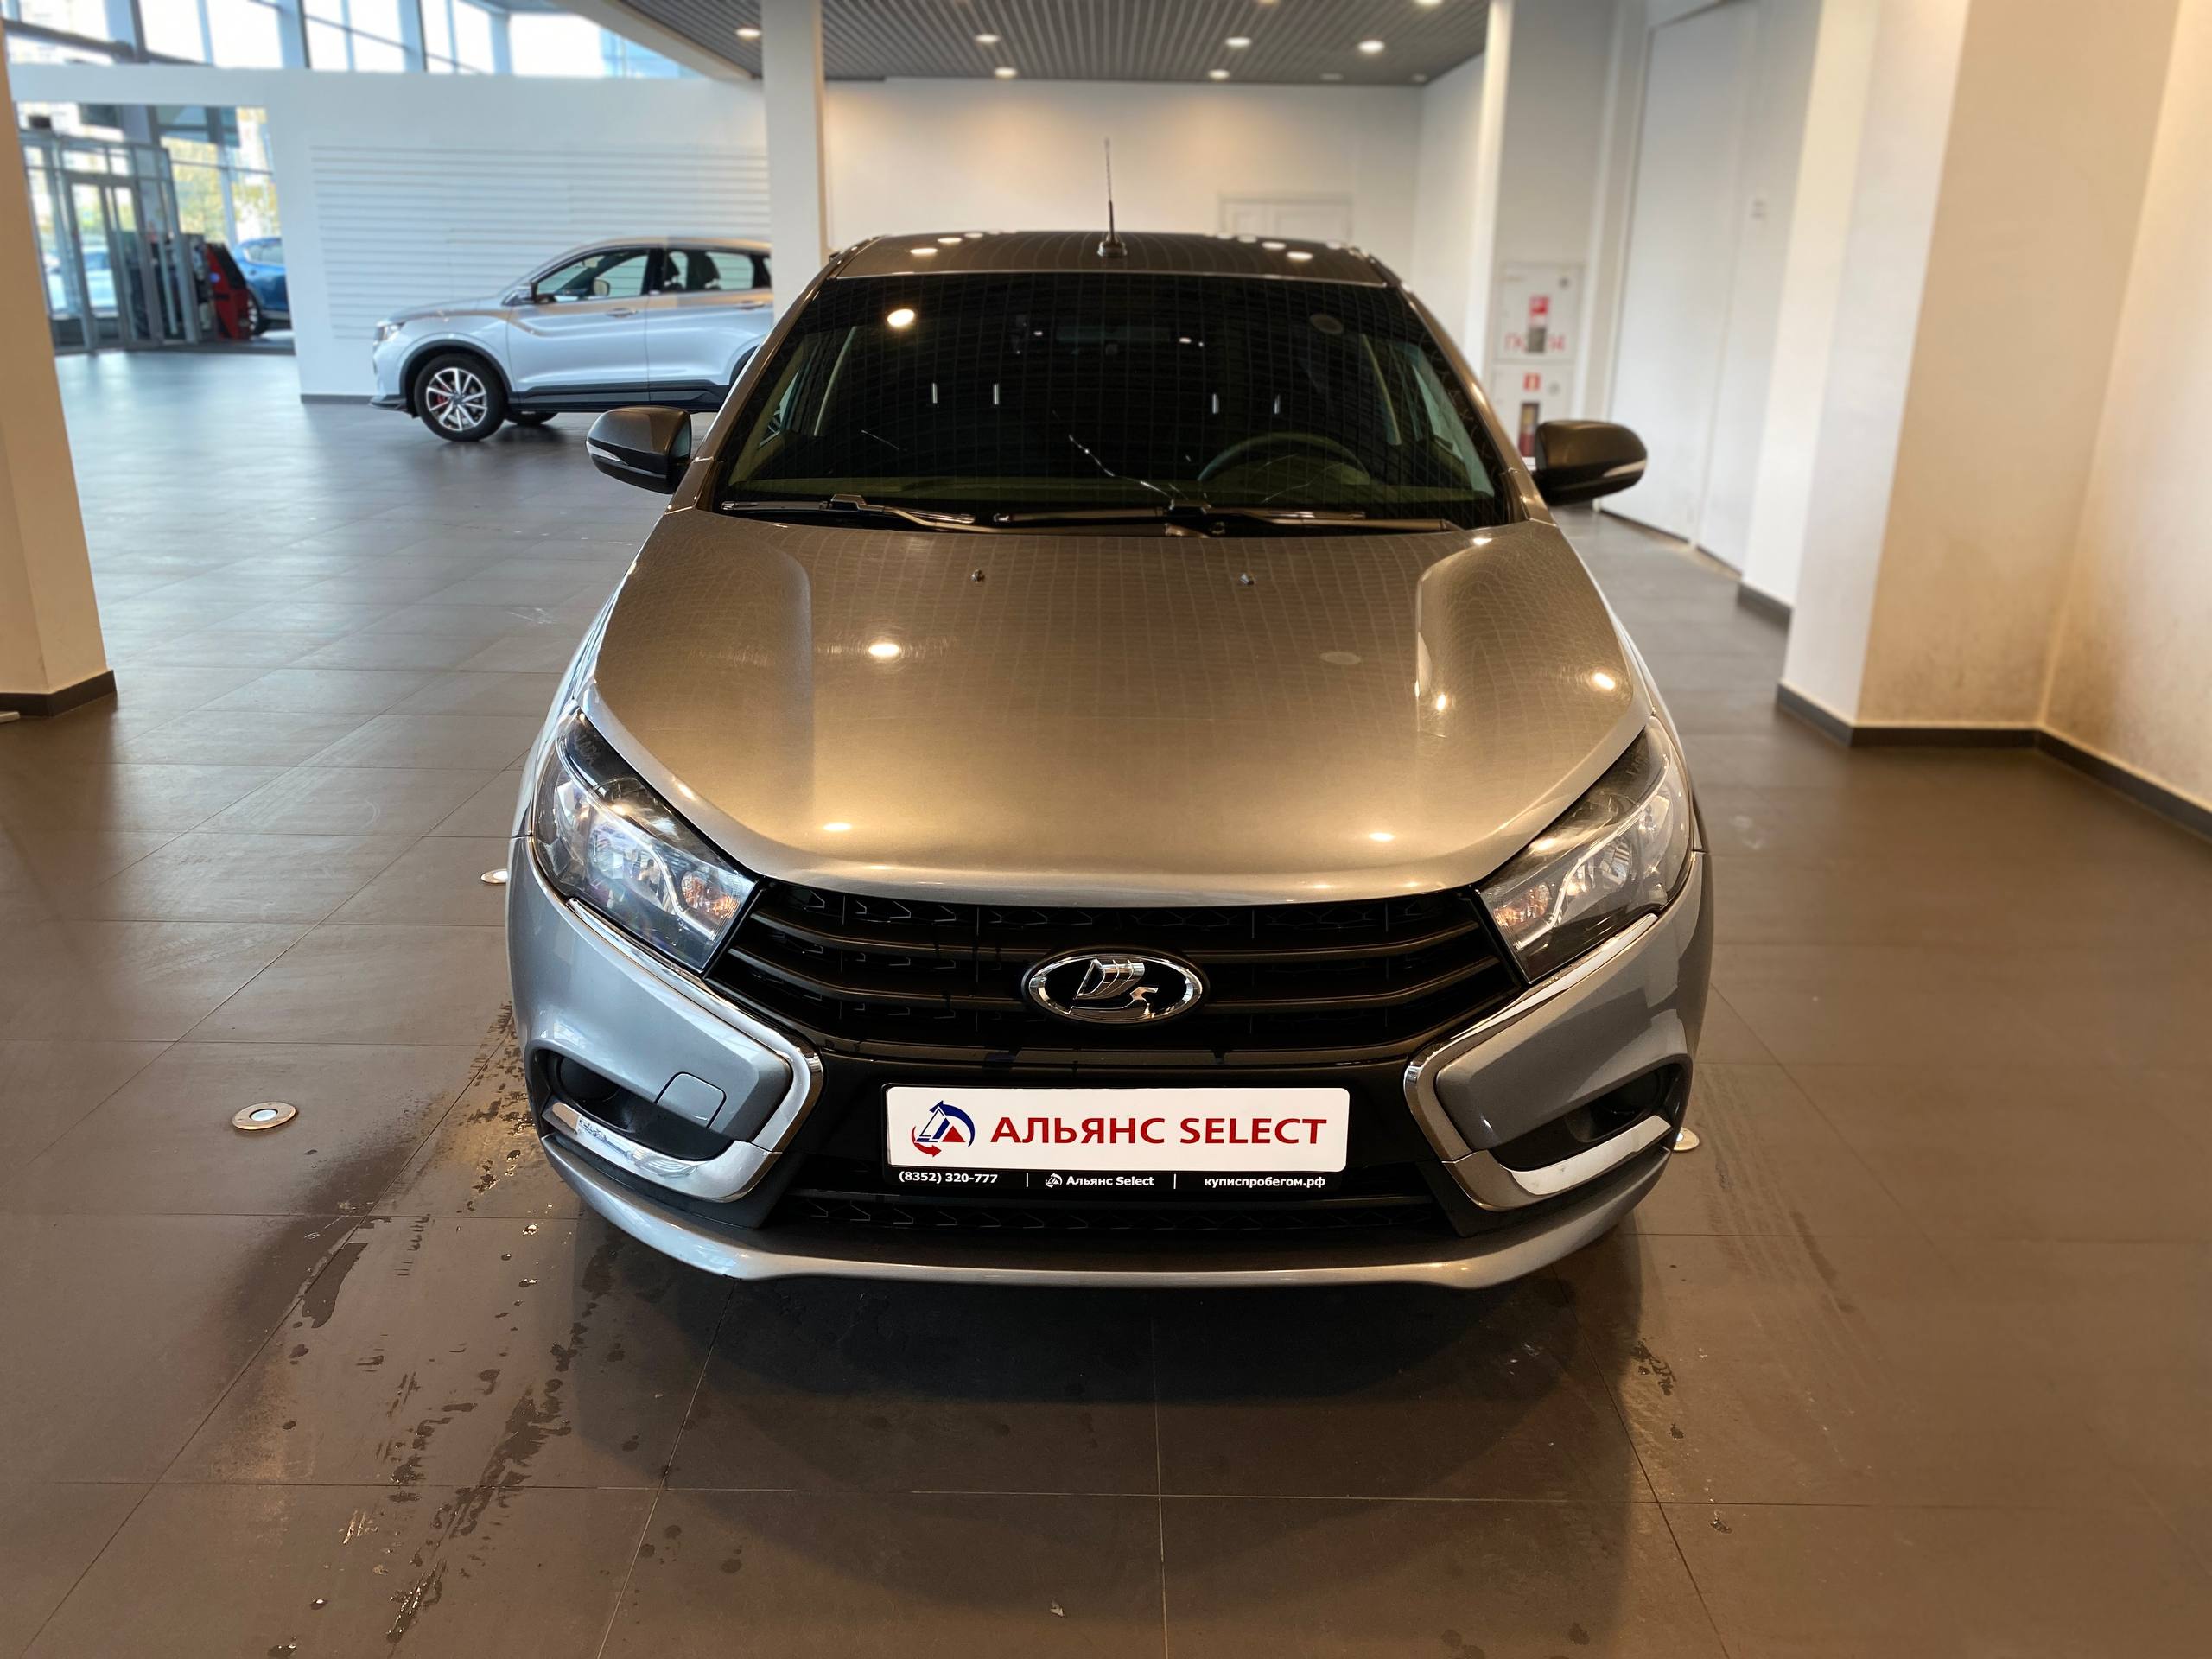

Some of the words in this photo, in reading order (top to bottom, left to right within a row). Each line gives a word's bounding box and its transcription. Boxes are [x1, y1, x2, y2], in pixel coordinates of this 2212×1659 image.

[990, 1116, 1166, 1145] АЛЬЯНС
[1179, 1117, 1328, 1145] SELECT
[899, 1171, 943, 1184] (8352)
[944, 1173, 998, 1184] 320-777
[1065, 1174, 1113, 1187] Альянс
[1116, 1174, 1155, 1186] Select
[1204, 1174, 1326, 1189] куписпробегом.рф
